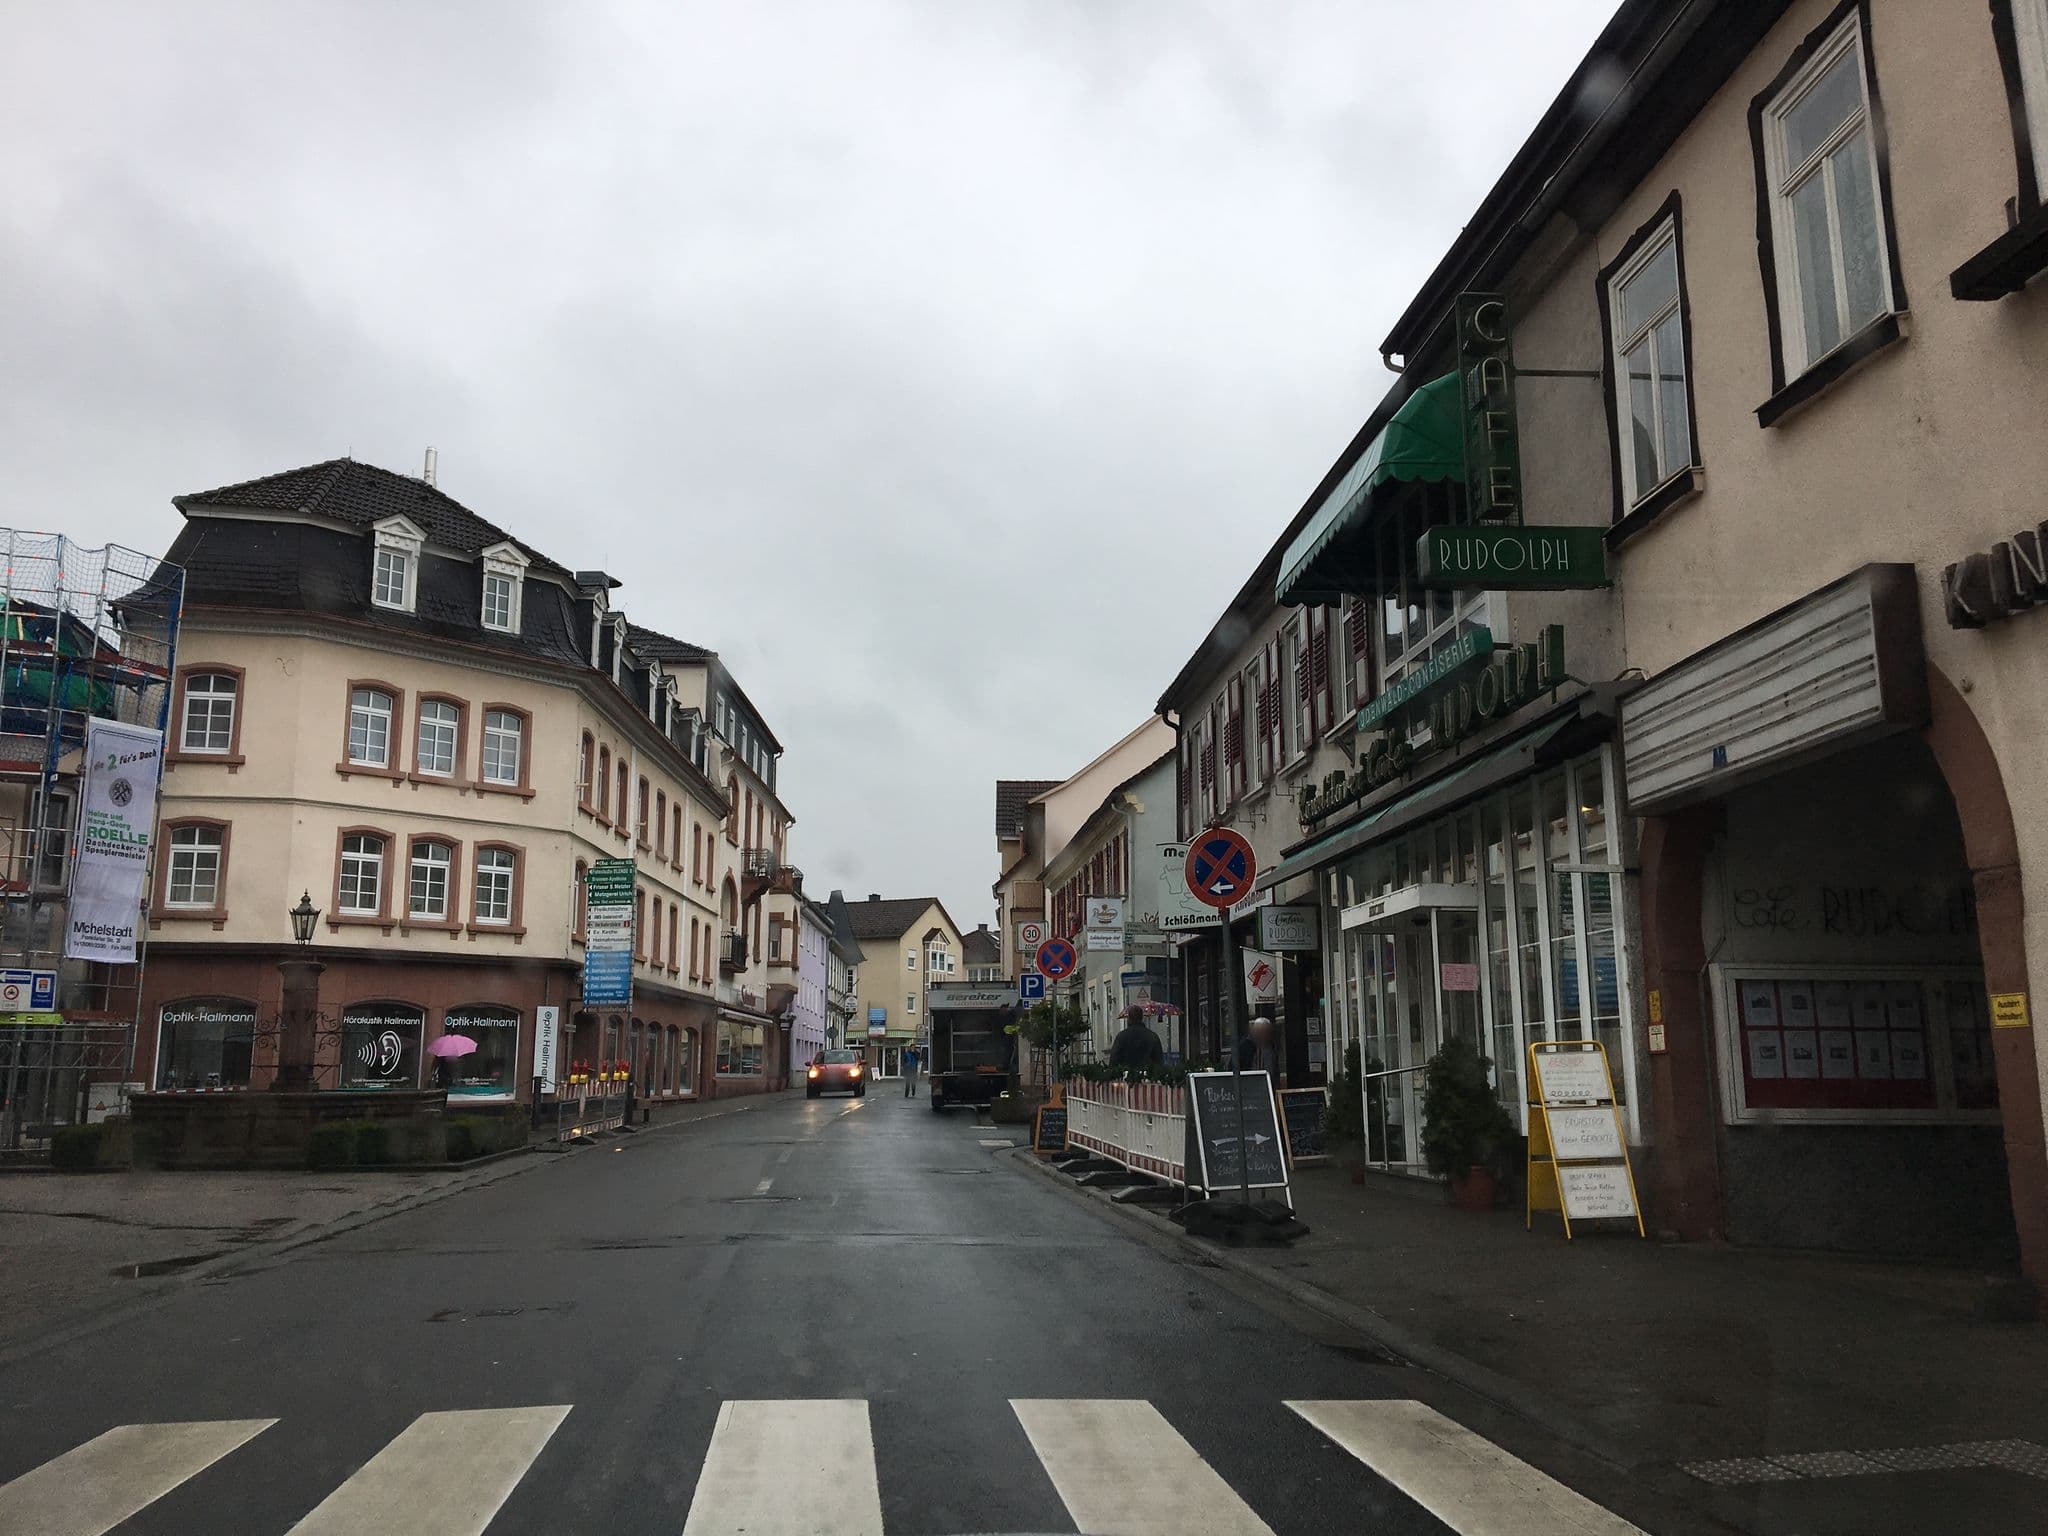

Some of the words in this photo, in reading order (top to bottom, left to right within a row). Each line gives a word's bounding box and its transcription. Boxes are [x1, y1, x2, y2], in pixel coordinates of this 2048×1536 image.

[1439, 537, 1569, 571] RUDOLPH
[1944, 520, 2048, 629] KIN
[107, 754, 117, 771] 2
[139, 749, 157, 761] Dach
[110, 813, 124, 821] und
[87, 826, 148, 845] ROELLE
[84, 845, 146, 861] Spenglermeister
[86, 838, 137, 852] Dachdecker-
[1026, 929, 1037, 938] 30
[1026, 978, 1039, 996] P
[163, 1011, 254, 1024] Optik-Hallmann
[384, 1016, 421, 1026] Hallmann
[445, 1015, 517, 1027] Optik-Hallmann
[543, 1011, 552, 1038] Optik
